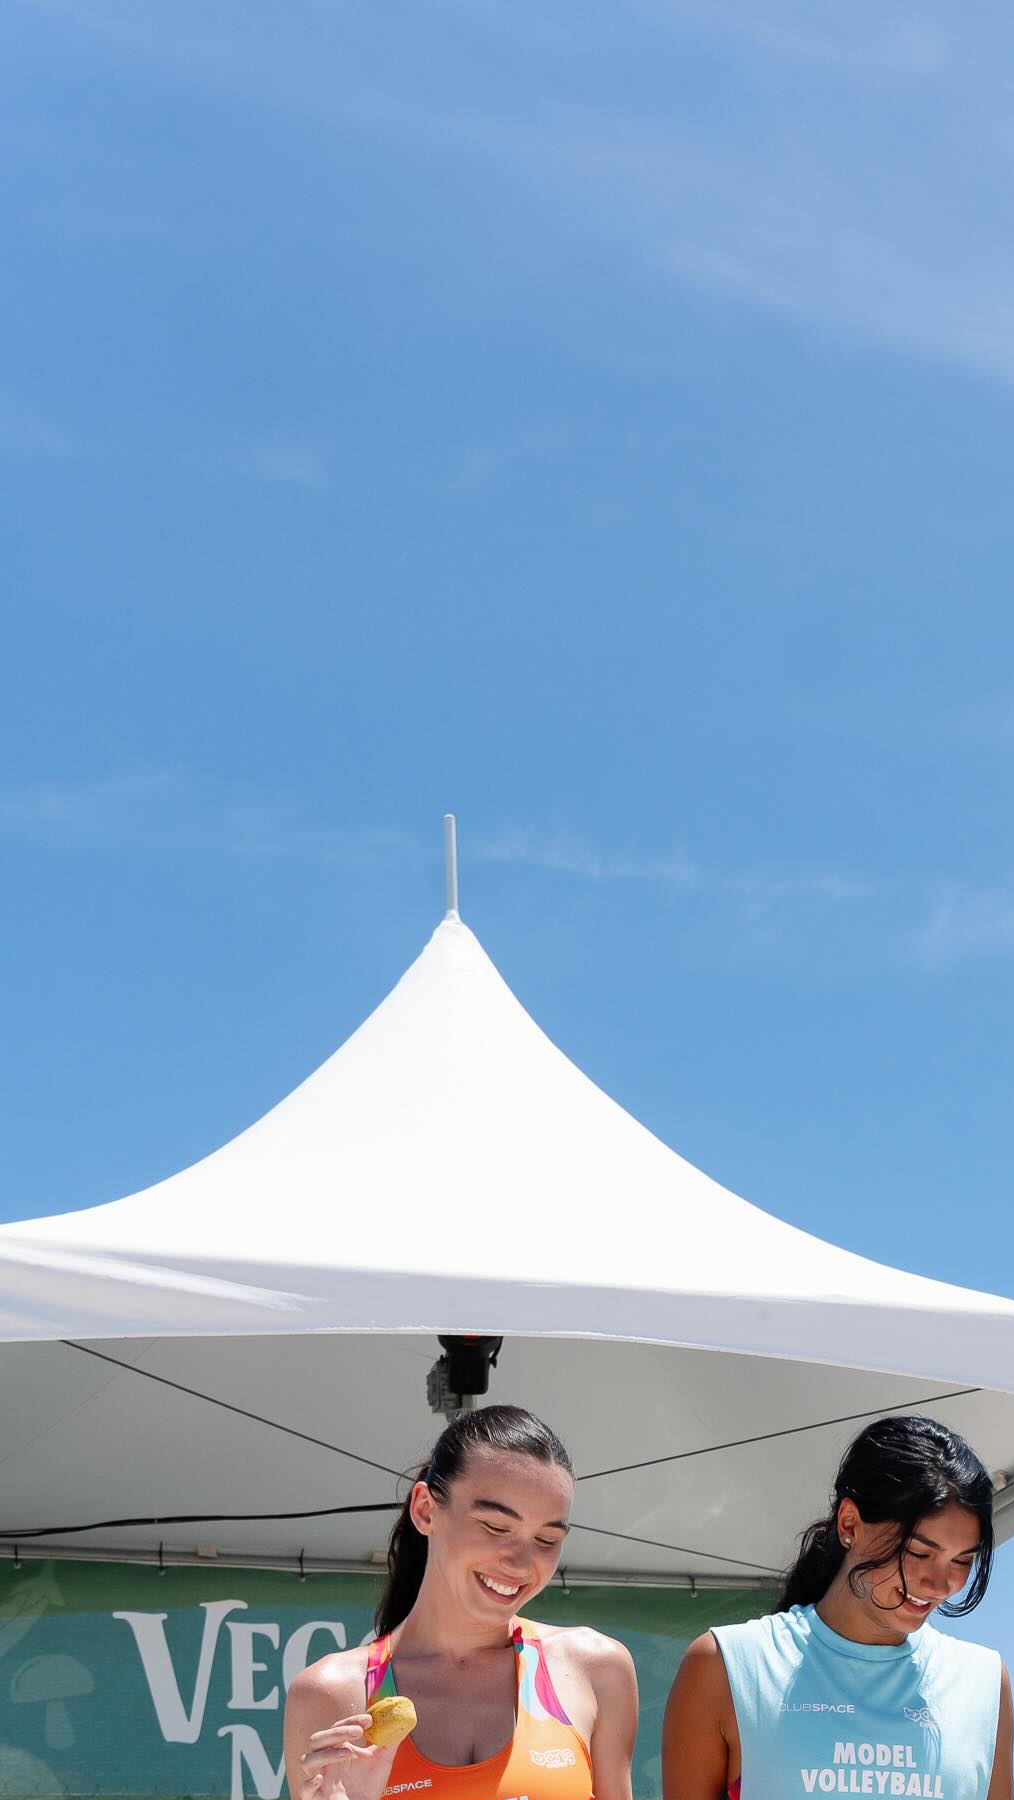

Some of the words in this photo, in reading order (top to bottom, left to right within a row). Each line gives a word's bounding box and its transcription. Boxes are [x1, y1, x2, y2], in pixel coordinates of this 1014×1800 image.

[833, 1742, 917, 1769] MODEL
[383, 1779, 433, 1796] BSPACE
[801, 1769, 944, 1799] VOLLEYBALL
